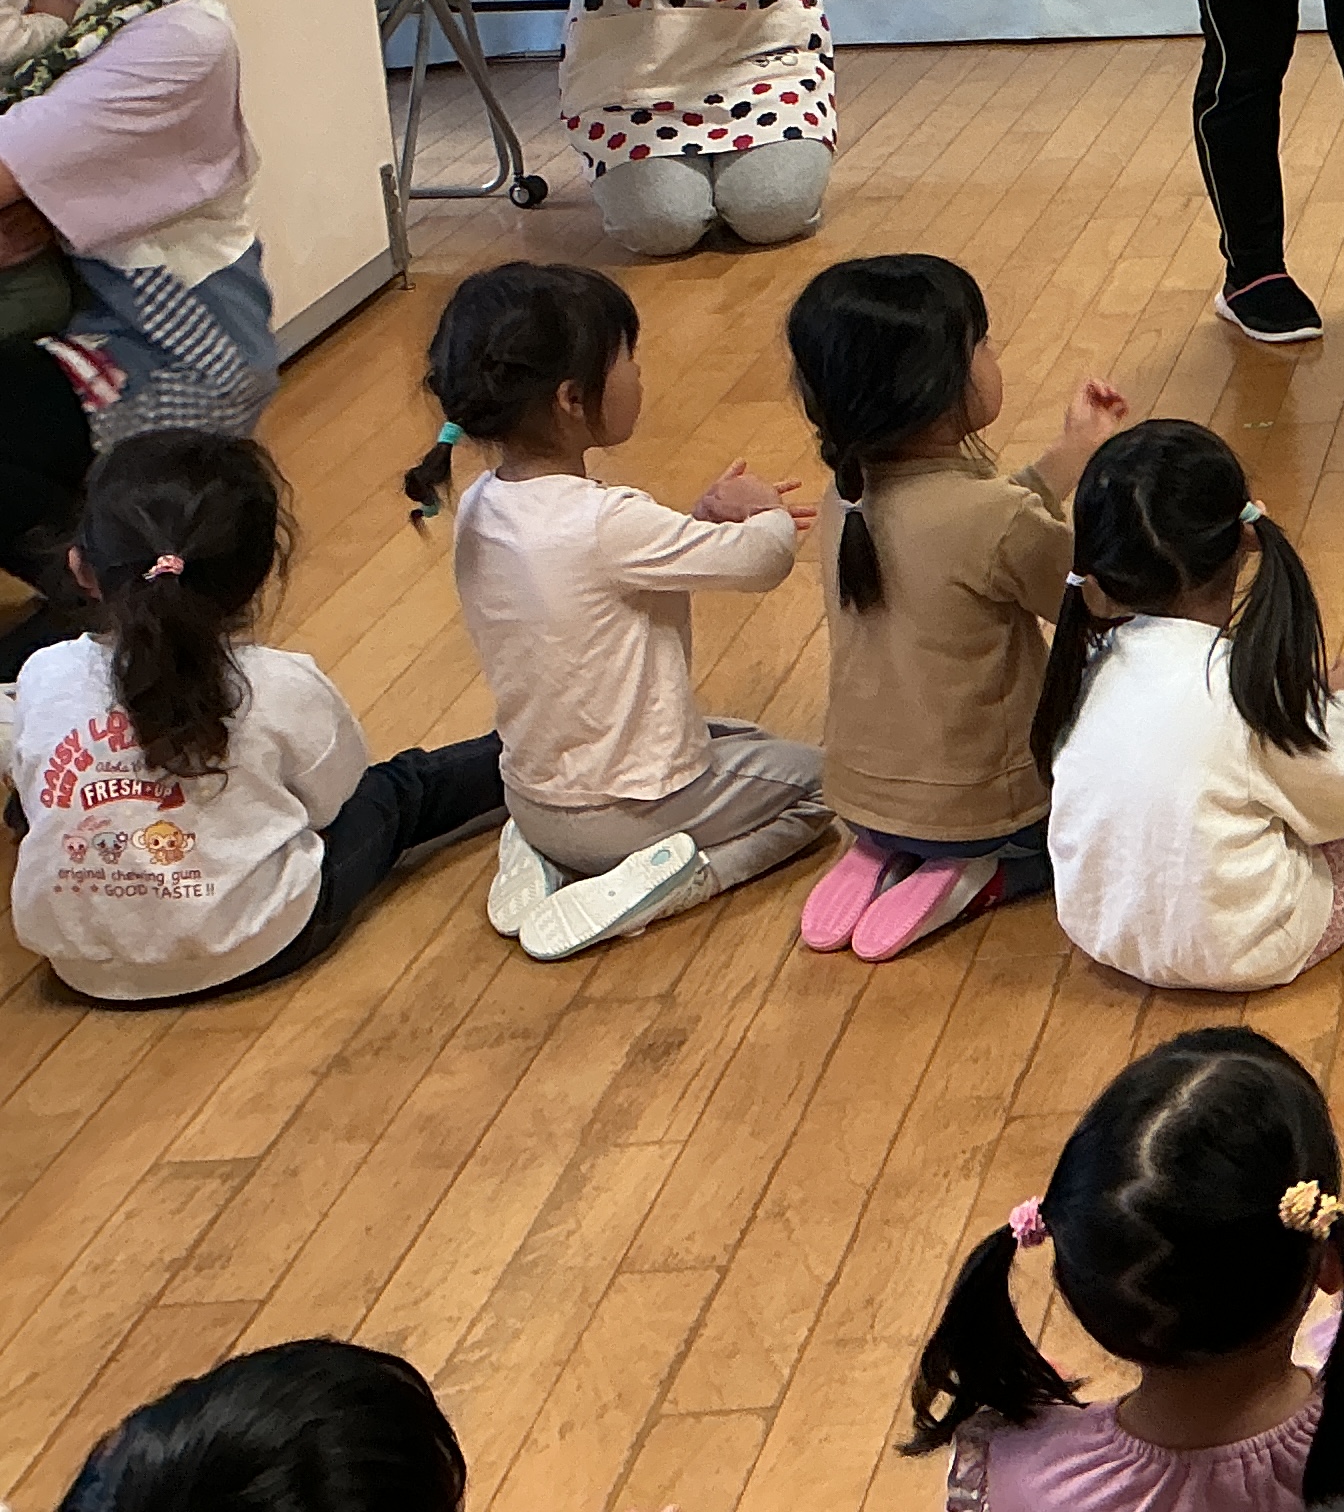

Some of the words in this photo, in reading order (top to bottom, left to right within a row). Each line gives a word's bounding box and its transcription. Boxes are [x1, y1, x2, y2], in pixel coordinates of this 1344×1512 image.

[84, 779, 143, 806] FRESH
[57, 867, 106, 883] original
[111, 869, 165, 886] chewing
[171, 868, 202, 885] gum
[104, 884, 148, 898] GOOD
